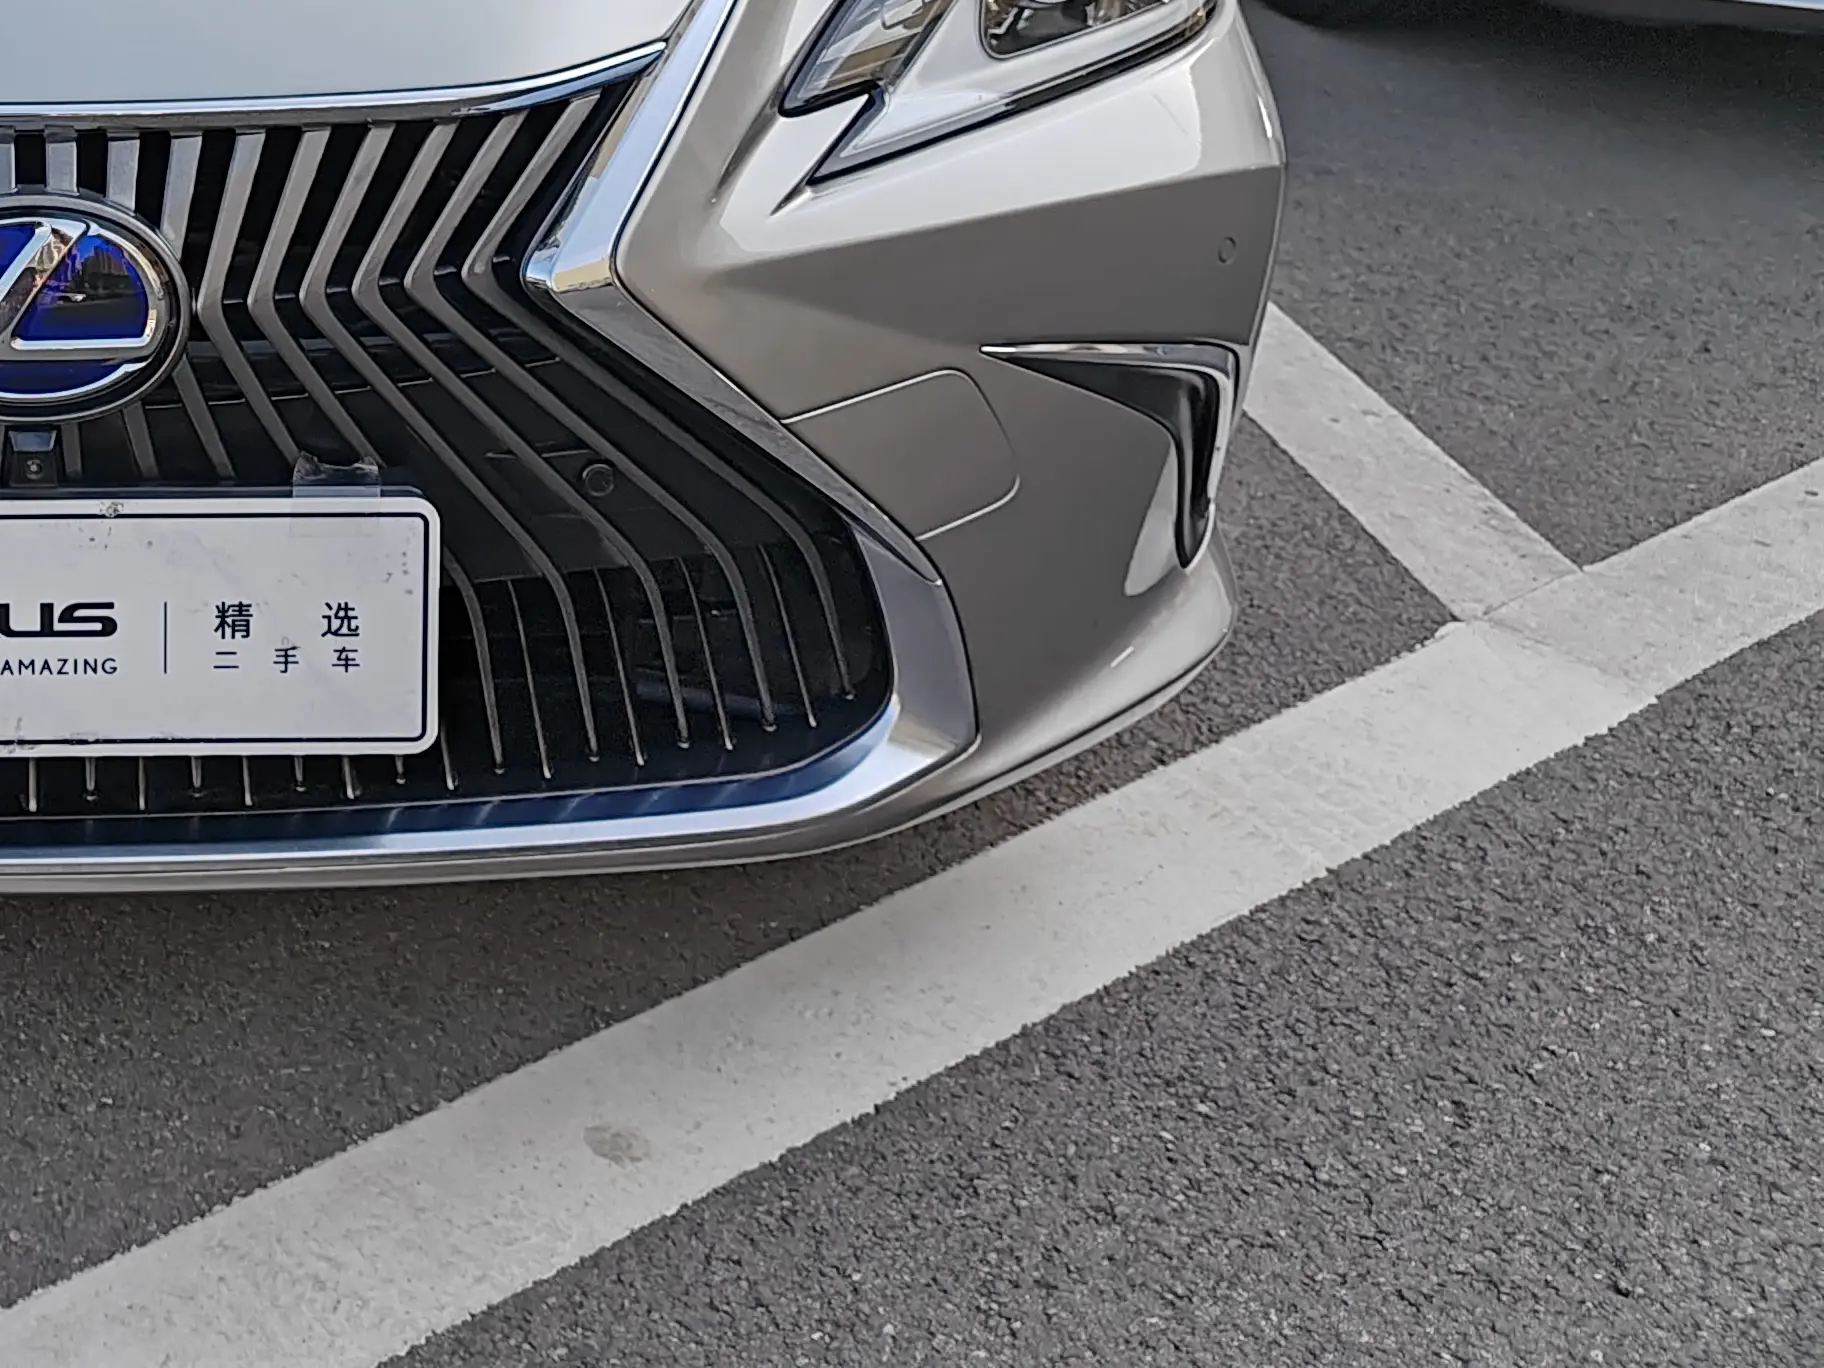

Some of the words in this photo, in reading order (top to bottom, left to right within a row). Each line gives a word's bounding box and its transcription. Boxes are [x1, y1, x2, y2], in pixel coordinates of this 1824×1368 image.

[0, 657, 118, 676] AMAZING
[213, 646, 361, 673] 二手车
